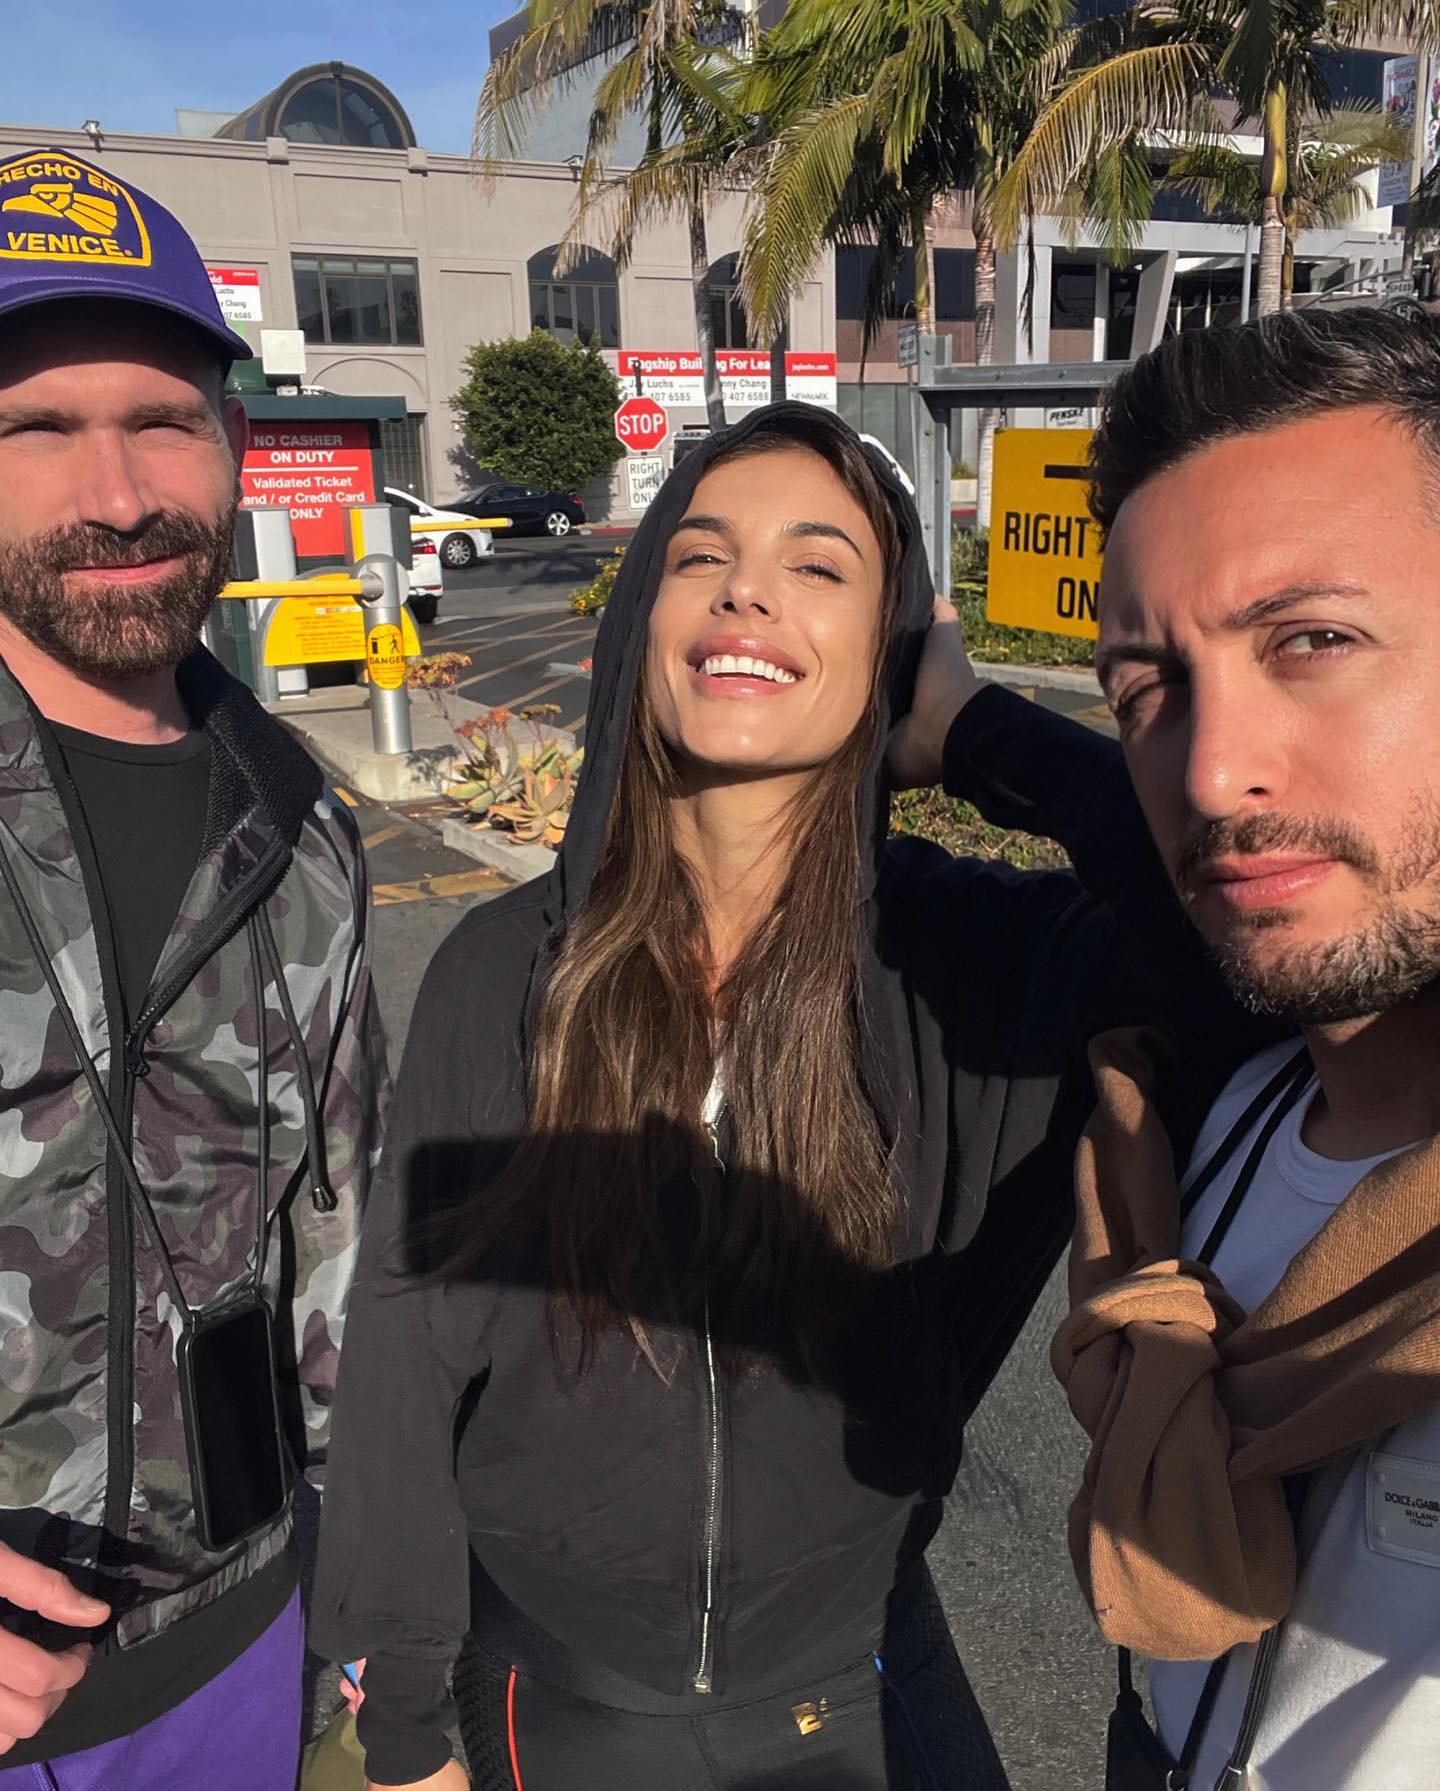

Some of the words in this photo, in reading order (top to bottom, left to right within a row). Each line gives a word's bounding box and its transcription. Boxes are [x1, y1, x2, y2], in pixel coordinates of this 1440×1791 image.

[0, 163, 81, 184] HECHO
[88, 173, 118, 196] EN
[729, 357, 748, 370] For
[750, 358, 771, 370] Lea
[647, 379, 674, 388] Luchs
[739, 378, 767, 389] Chang
[668, 391, 692, 401] 6585
[729, 391, 745, 401] 407
[747, 391, 769, 401] 6588
[620, 413, 664, 436] STOP
[254, 435, 275, 447] NO
[280, 434, 343, 447] CASHIER
[270, 451, 292, 464] ON
[295, 451, 334, 463] DUTY
[630, 462, 660, 474] RIGHT
[252, 477, 311, 489] Validated
[313, 476, 353, 487] Ticket
[632, 477, 660, 489] TURN
[243, 493, 267, 505] and
[278, 494, 291, 503] or
[294, 492, 333, 503] Credit
[335, 491, 365, 502] Card
[289, 508, 324, 520] ONLY
[1003, 511, 1091, 558] RIGHT
[1056, 576, 1100, 622] ON
[1405, 1509, 1438, 1522] MILANO
[1410, 1518, 1433, 1527] ITALIA
